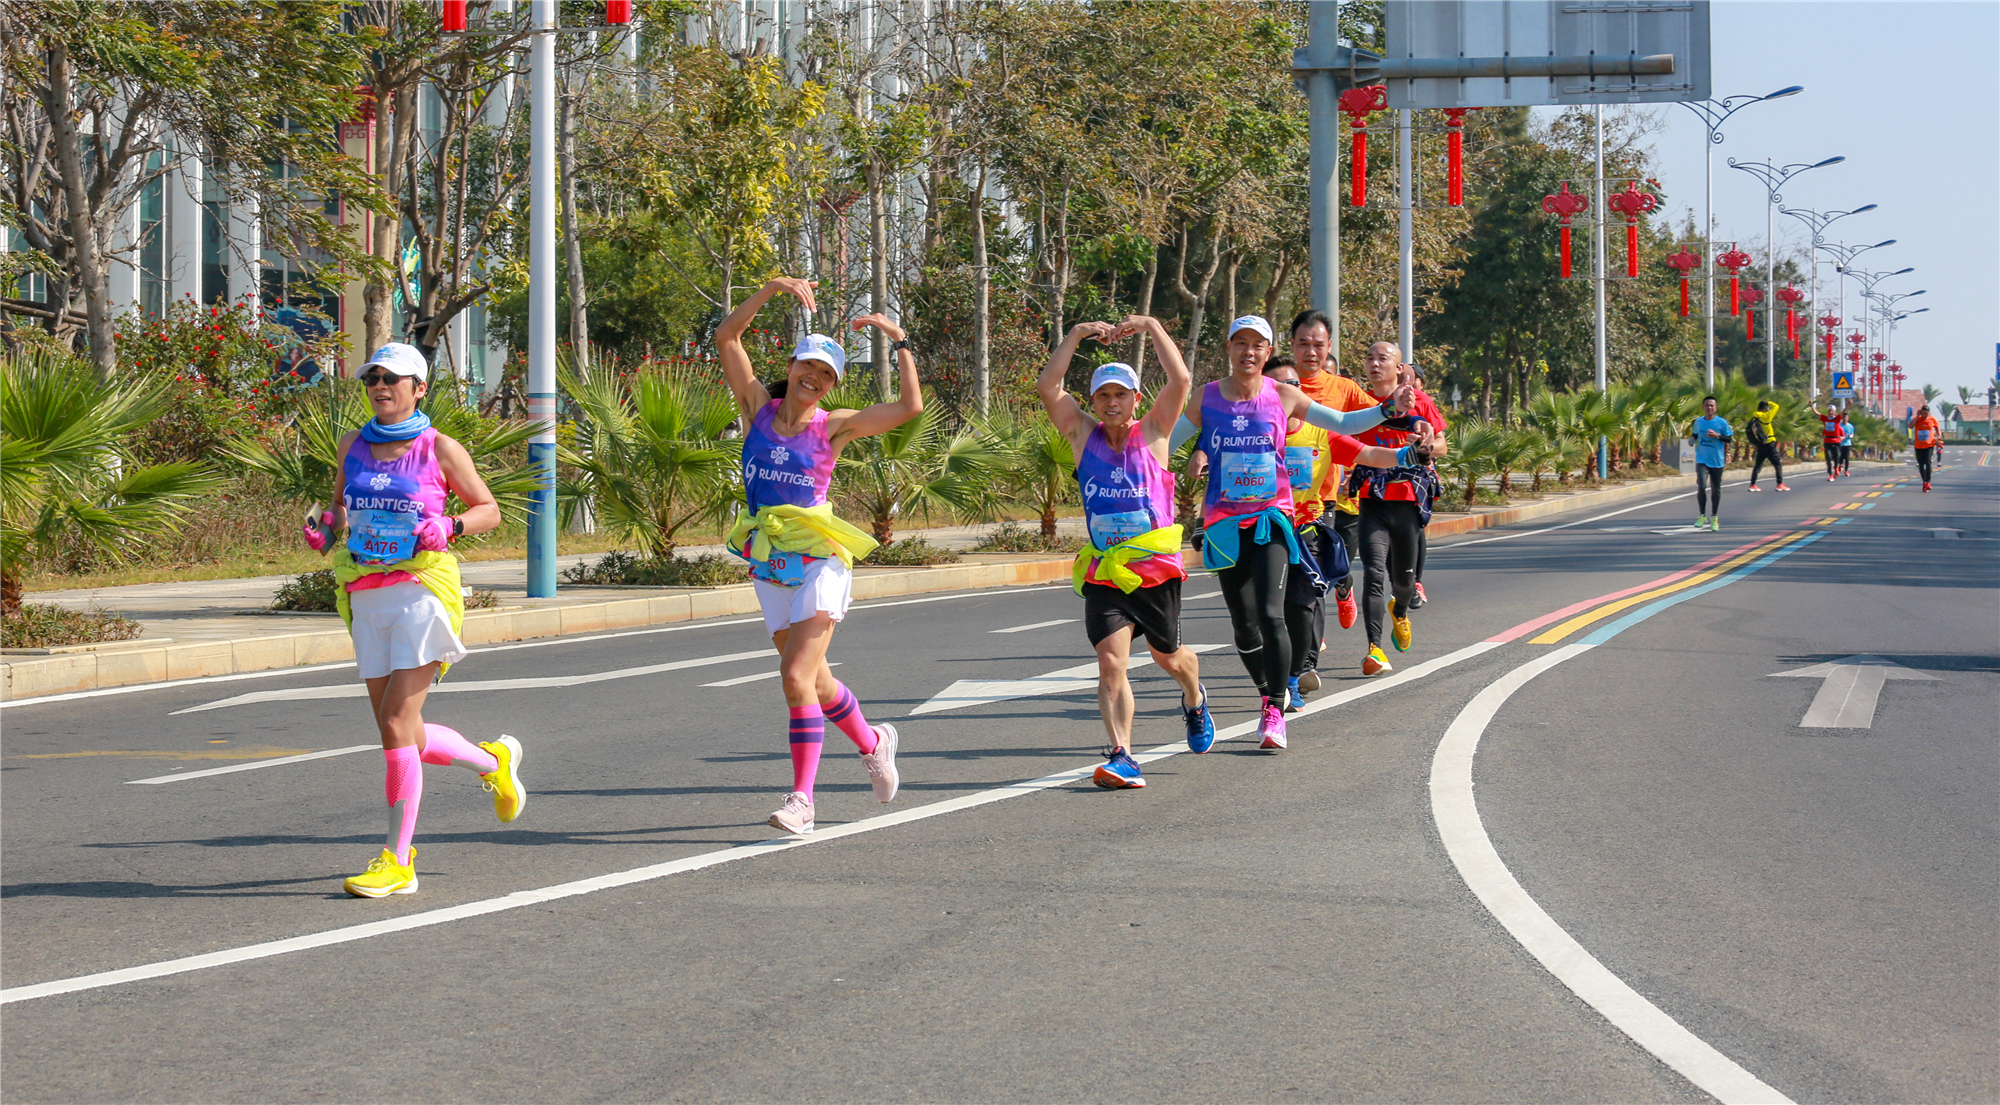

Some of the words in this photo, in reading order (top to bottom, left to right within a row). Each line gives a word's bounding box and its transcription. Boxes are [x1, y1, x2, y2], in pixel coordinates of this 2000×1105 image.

[1223, 435, 1274, 447] RUNTIGER
[758, 468, 815, 488] RUNTIGER
[1234, 476, 1265, 487] A060
[1098, 487, 1150, 498] RUNTIGER
[356, 497, 425, 514] RUNTIGER
[363, 540, 398, 554] A176
